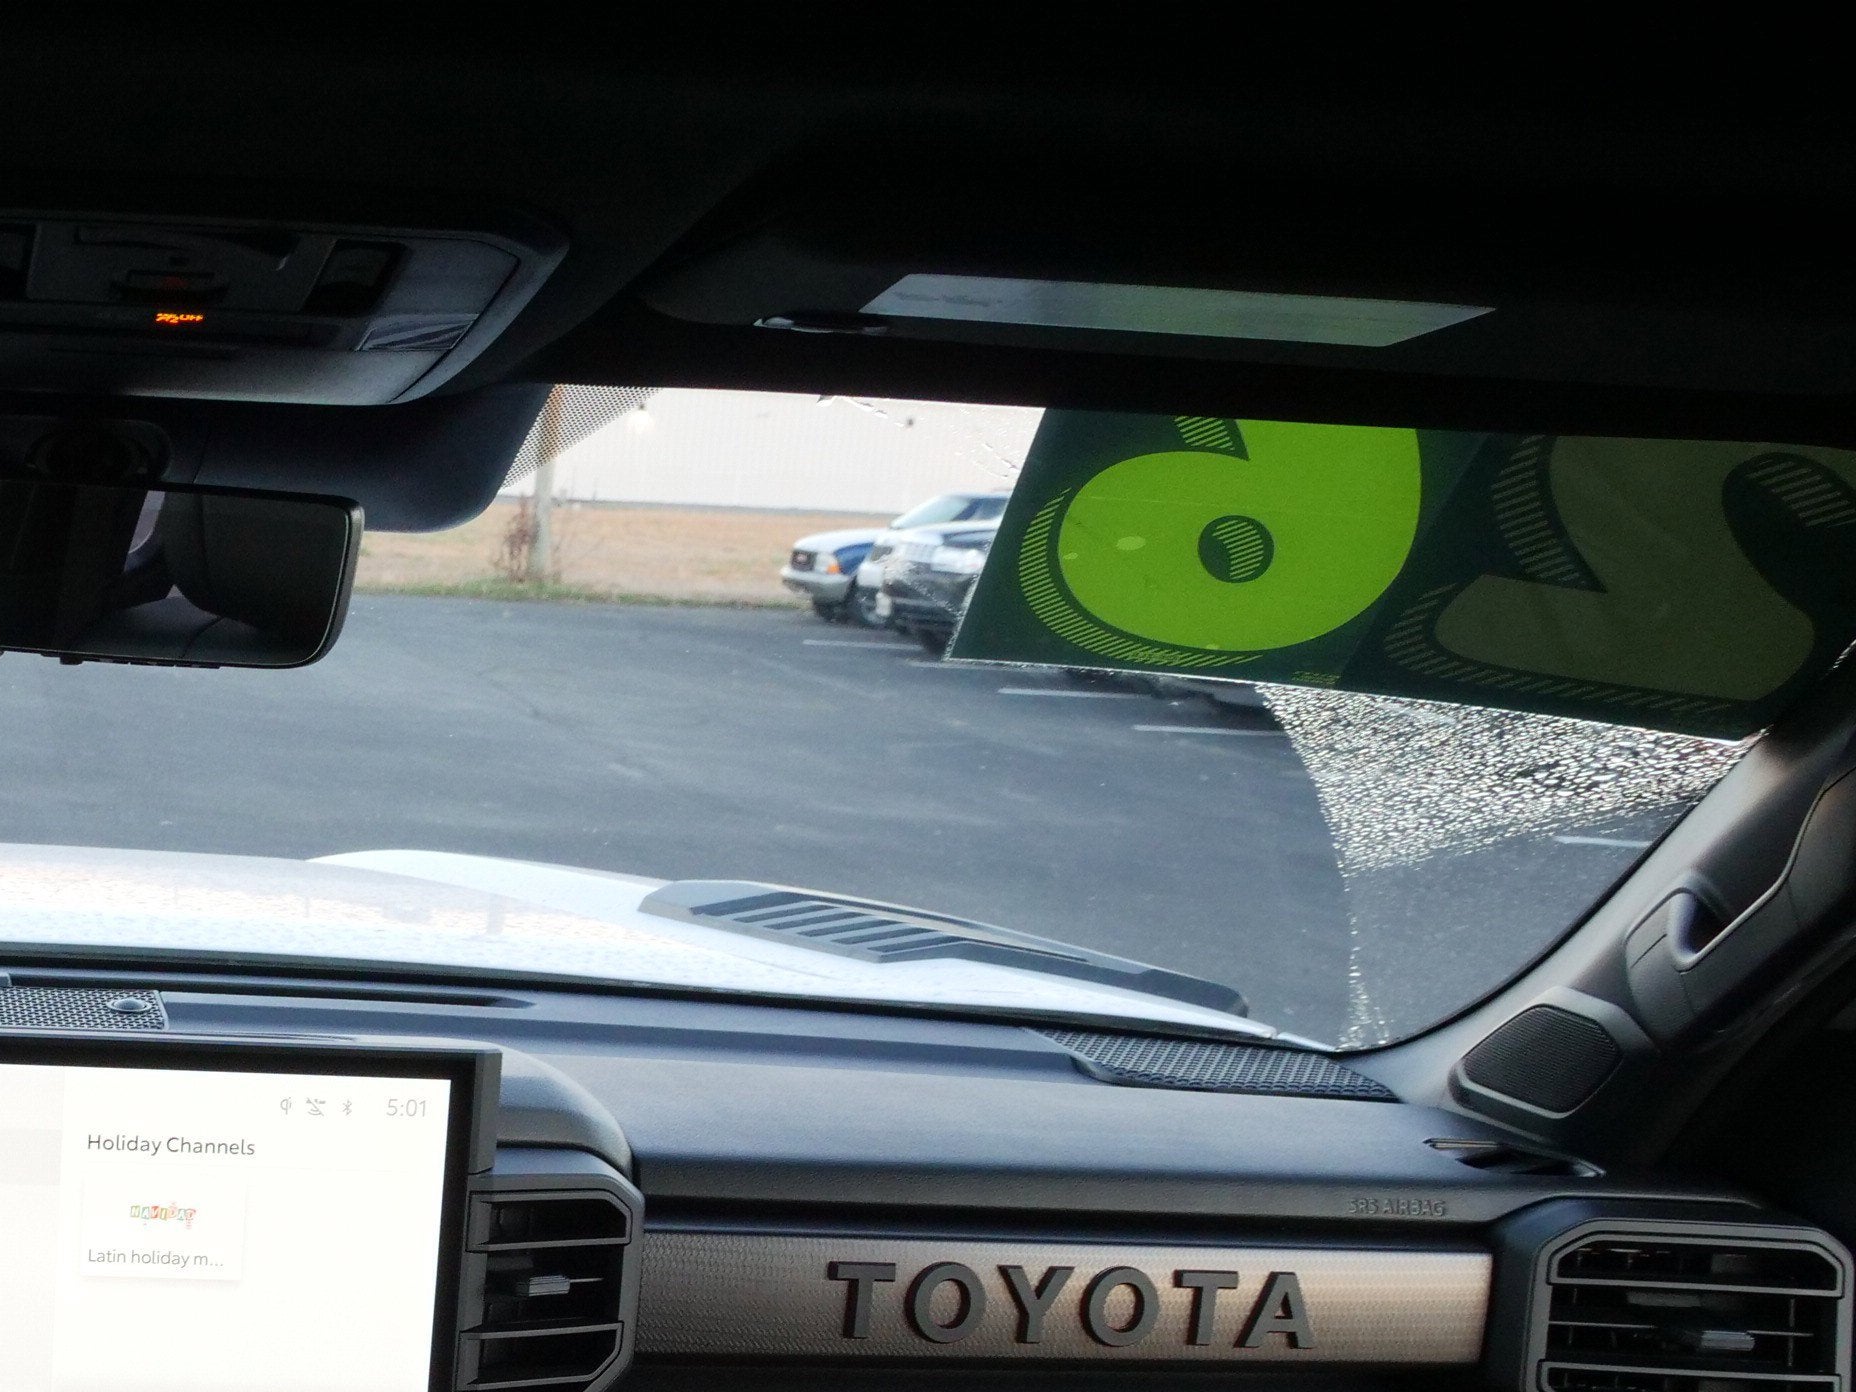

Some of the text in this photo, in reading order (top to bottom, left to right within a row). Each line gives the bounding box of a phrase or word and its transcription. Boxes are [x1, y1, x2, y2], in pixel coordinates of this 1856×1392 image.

[385, 1098, 428, 1118] 5:01
[87, 1134, 256, 1157] Holiday Channels
[1348, 1198, 1446, 1217] SRS AIRBAG
[87, 1248, 126, 1264] Latin
[130, 1249, 190, 1269] holiday
[828, 1260, 1315, 1350] TOYOTA
